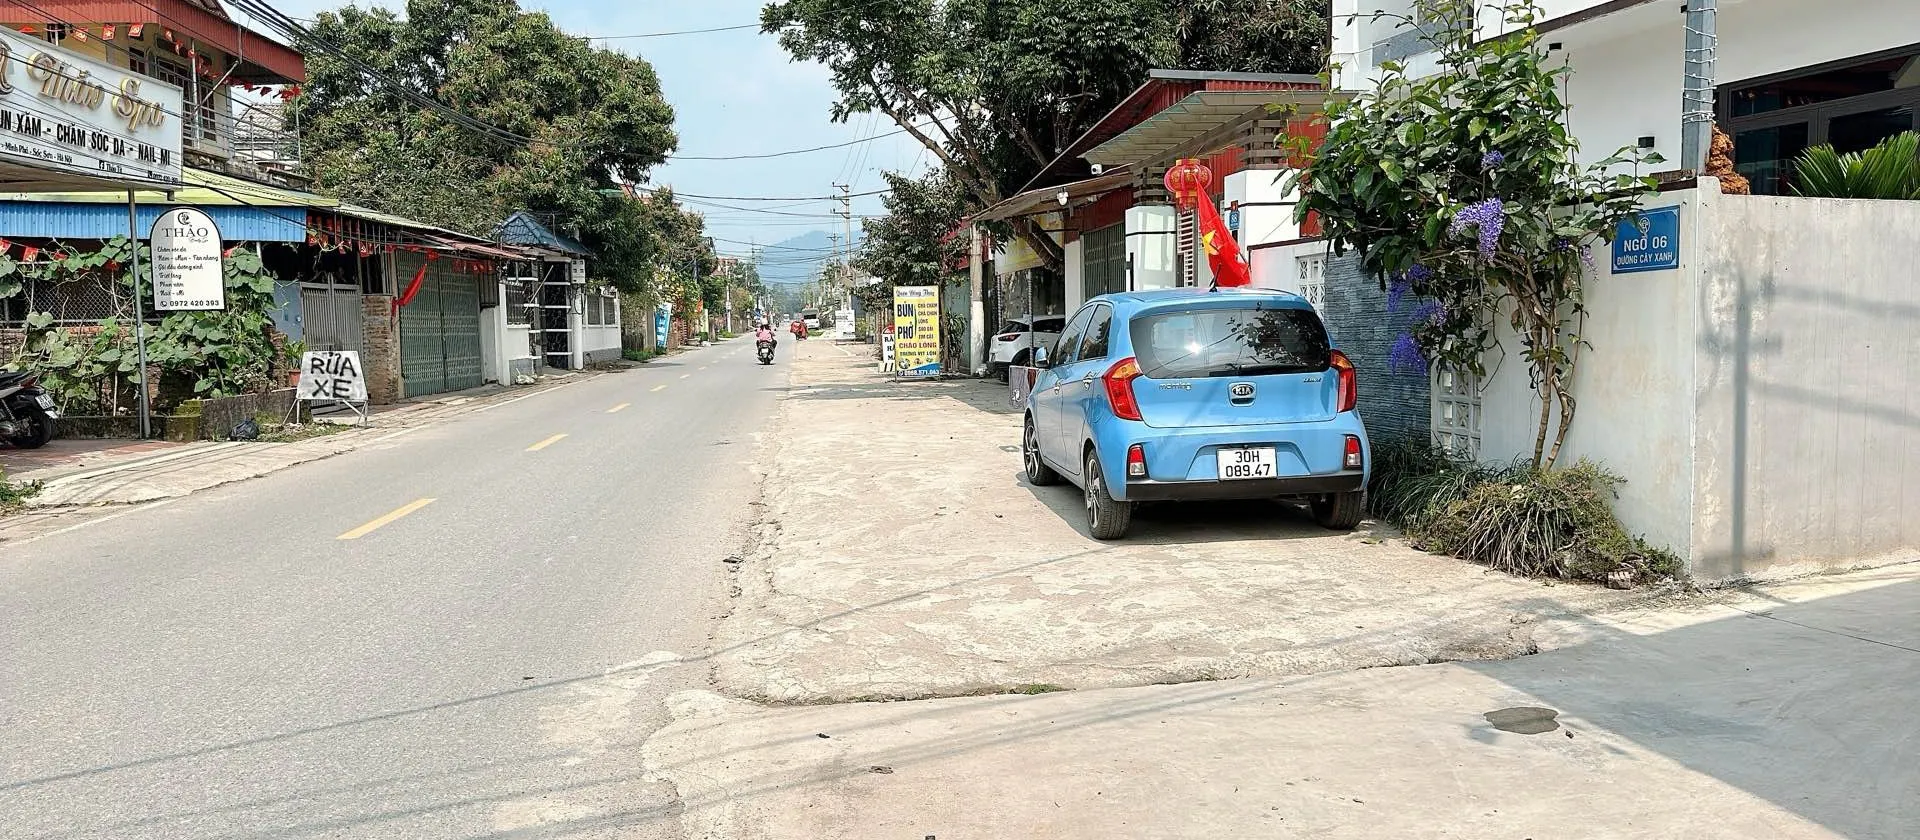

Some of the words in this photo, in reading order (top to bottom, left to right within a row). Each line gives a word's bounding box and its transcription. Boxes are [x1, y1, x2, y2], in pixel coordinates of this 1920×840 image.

[112, 77, 167, 132] Spa
[17, 111, 41, 137] XĂM
[57, 122, 86, 147] CHĂM
[91, 129, 109, 152] SÓC
[113, 137, 125, 156] DA
[138, 143, 157, 163] NAIL
[161, 224, 209, 238] THẢO
[1652, 235, 1668, 249] 06
[1616, 254, 1638, 266] ĐƯỜNG
[1639, 252, 1653, 263] CÂY
[1654, 251, 1673, 262] XANH
[310, 352, 357, 377] RỬA
[312, 379, 352, 398] XE
[1235, 386, 1252, 395] KIA
[1235, 450, 1260, 463] 30H
[1225, 464, 1271, 477] 089.47
